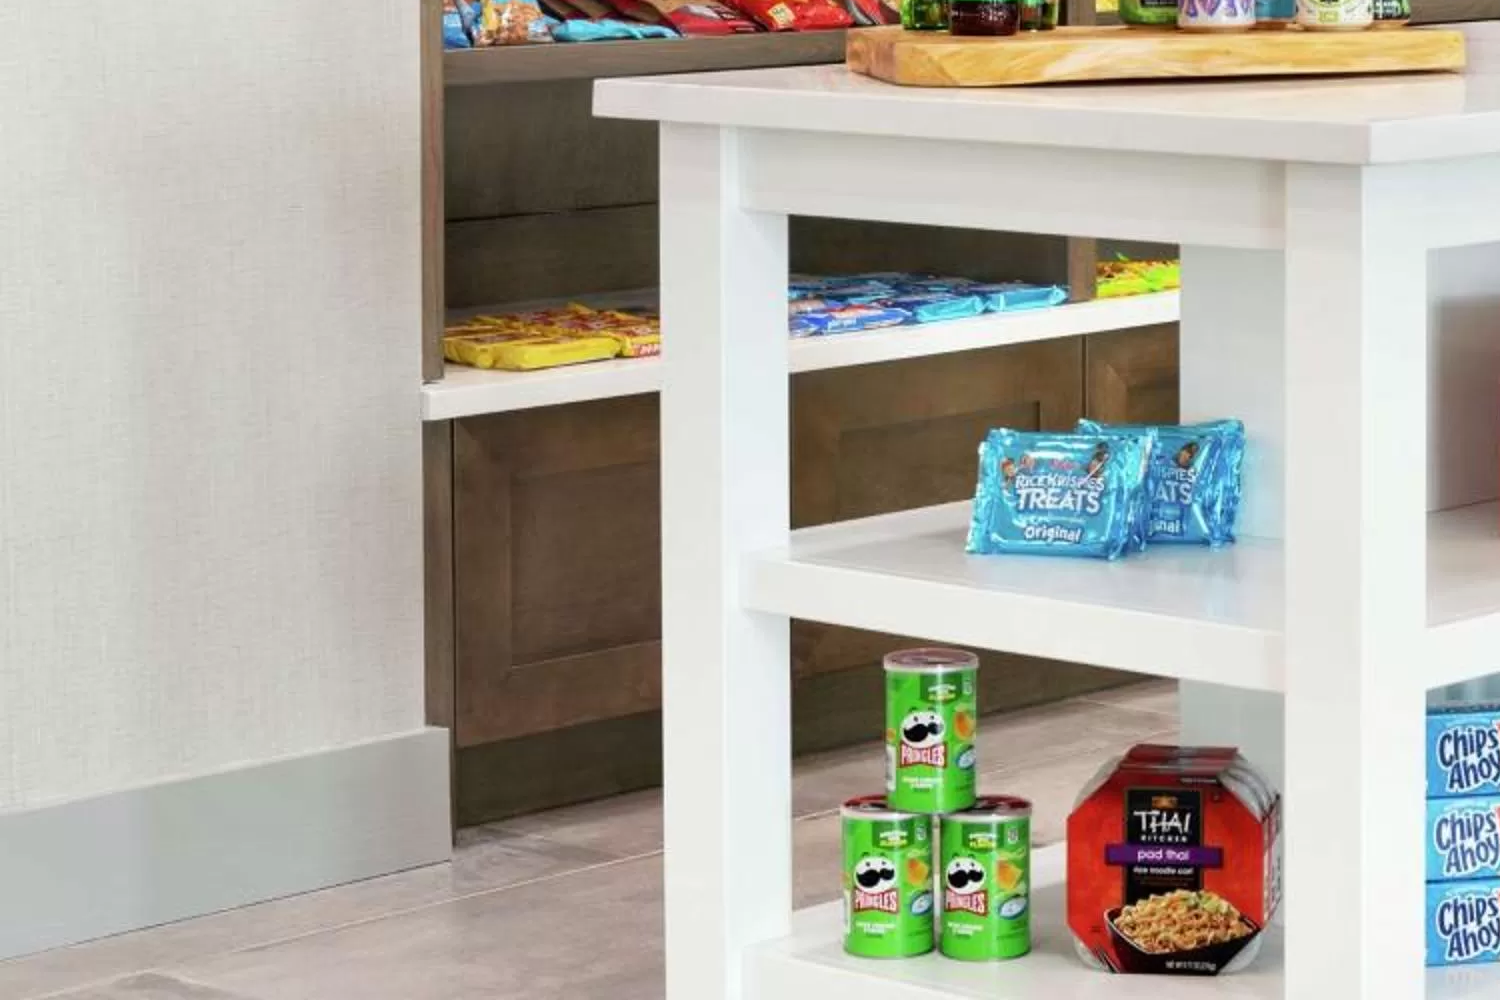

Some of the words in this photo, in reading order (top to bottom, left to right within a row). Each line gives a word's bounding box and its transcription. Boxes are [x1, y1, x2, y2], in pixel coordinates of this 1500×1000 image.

[1016, 487, 1101, 514] TREATS
[1024, 524, 1082, 543] Original
[1438, 724, 1500, 768] Chips
[1133, 809, 1192, 834] THAI
[1435, 811, 1497, 853] Chips
[1136, 849, 1163, 862] pad
[1166, 848, 1190, 861] thai
[855, 890, 897, 914] PRINGLES
[1438, 894, 1499, 937] Chips
